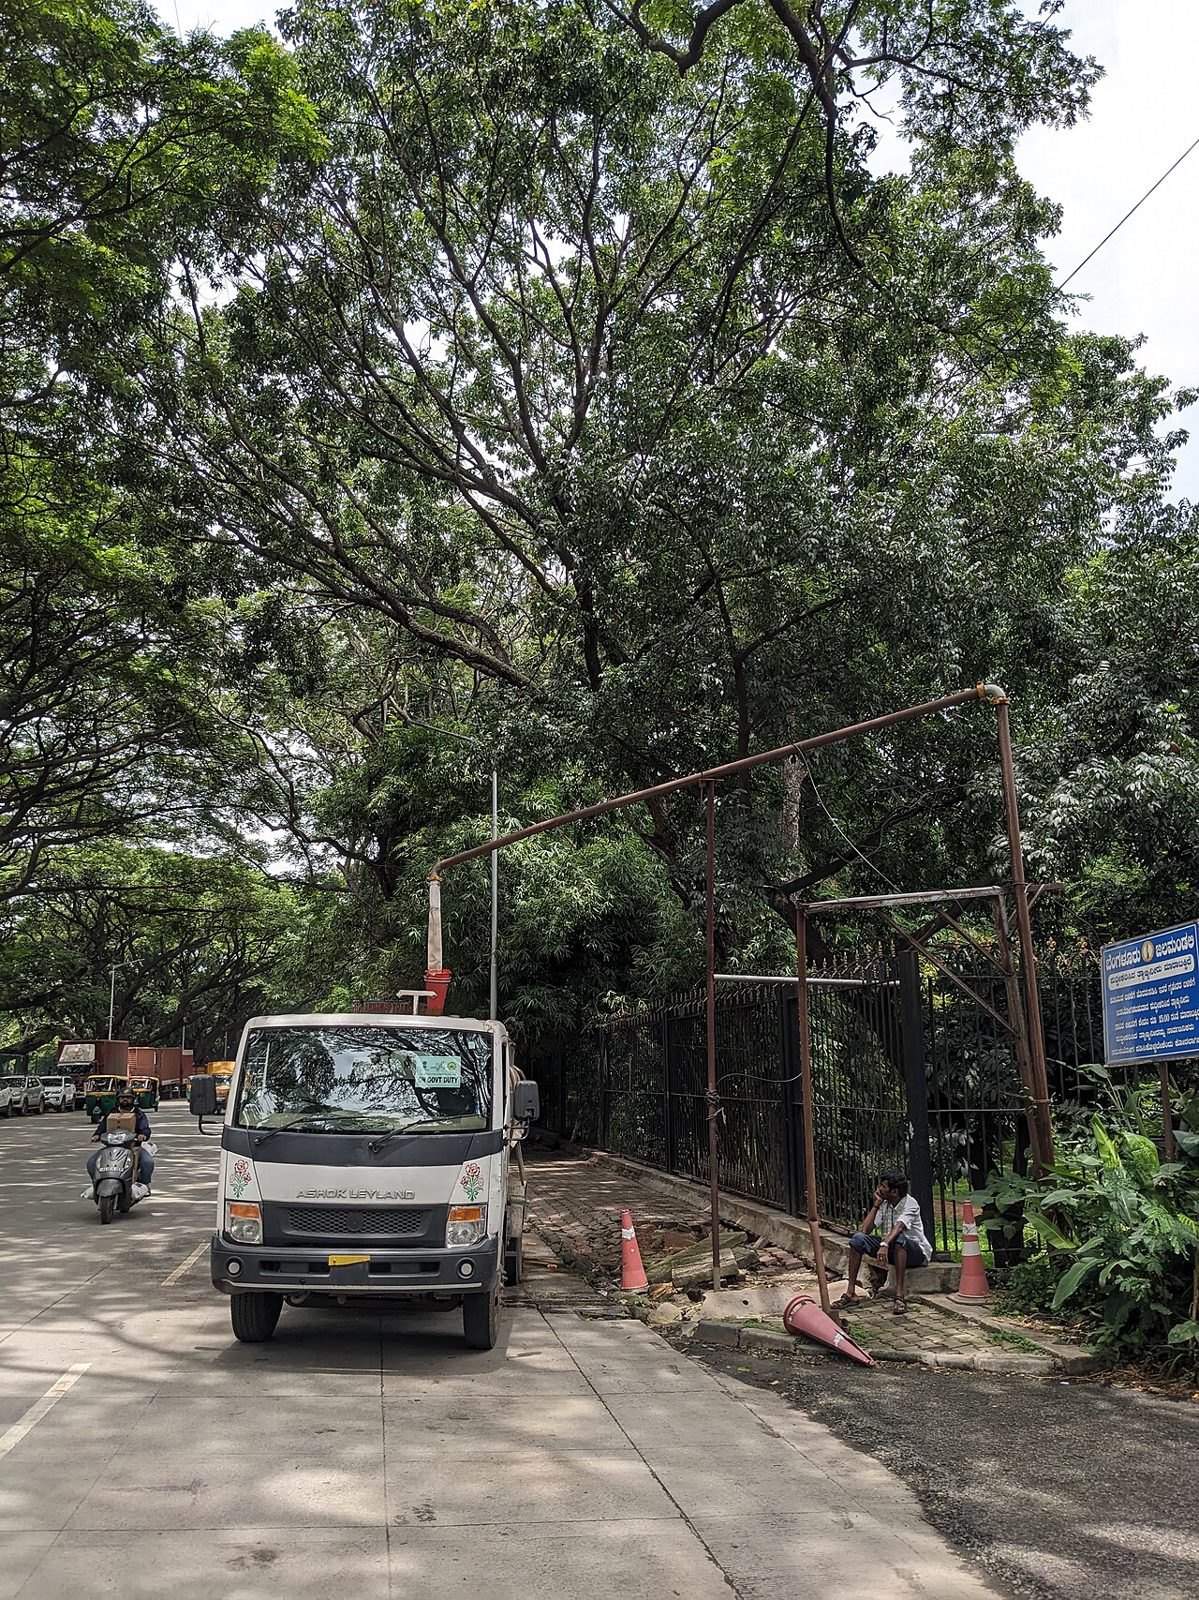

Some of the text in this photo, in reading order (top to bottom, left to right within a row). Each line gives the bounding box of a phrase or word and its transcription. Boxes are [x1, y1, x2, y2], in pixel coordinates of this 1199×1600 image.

[1106, 947, 1141, 970] ಬೆಂಗಳೂರು
[296, 1189, 415, 1200] ASHOK LEYLAND
